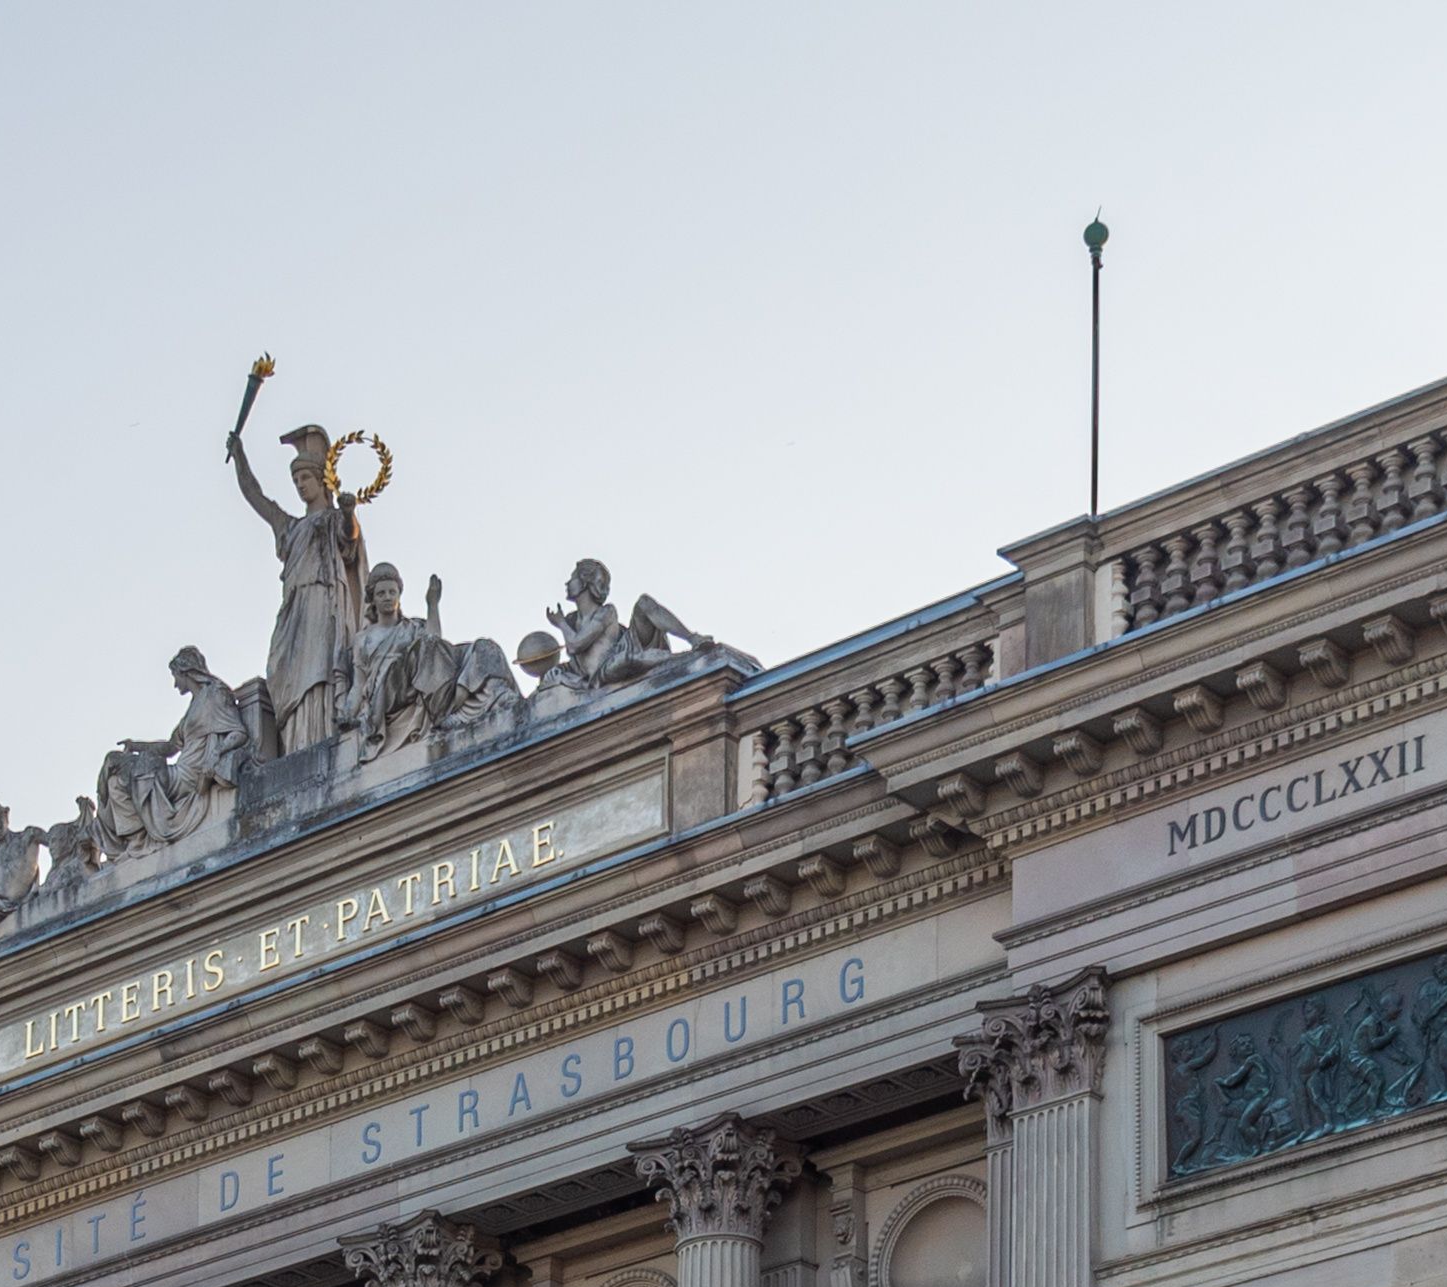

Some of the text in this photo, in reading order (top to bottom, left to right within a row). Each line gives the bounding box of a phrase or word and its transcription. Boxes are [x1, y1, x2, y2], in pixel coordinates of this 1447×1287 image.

[1166, 734, 1427, 856] MDCCCLXXII
[24, 949, 225, 1060] LITTERIS
[258, 915, 312, 972] ET
[219, 1153, 285, 1213] DE
[360, 956, 866, 1166] STRASBOURG
